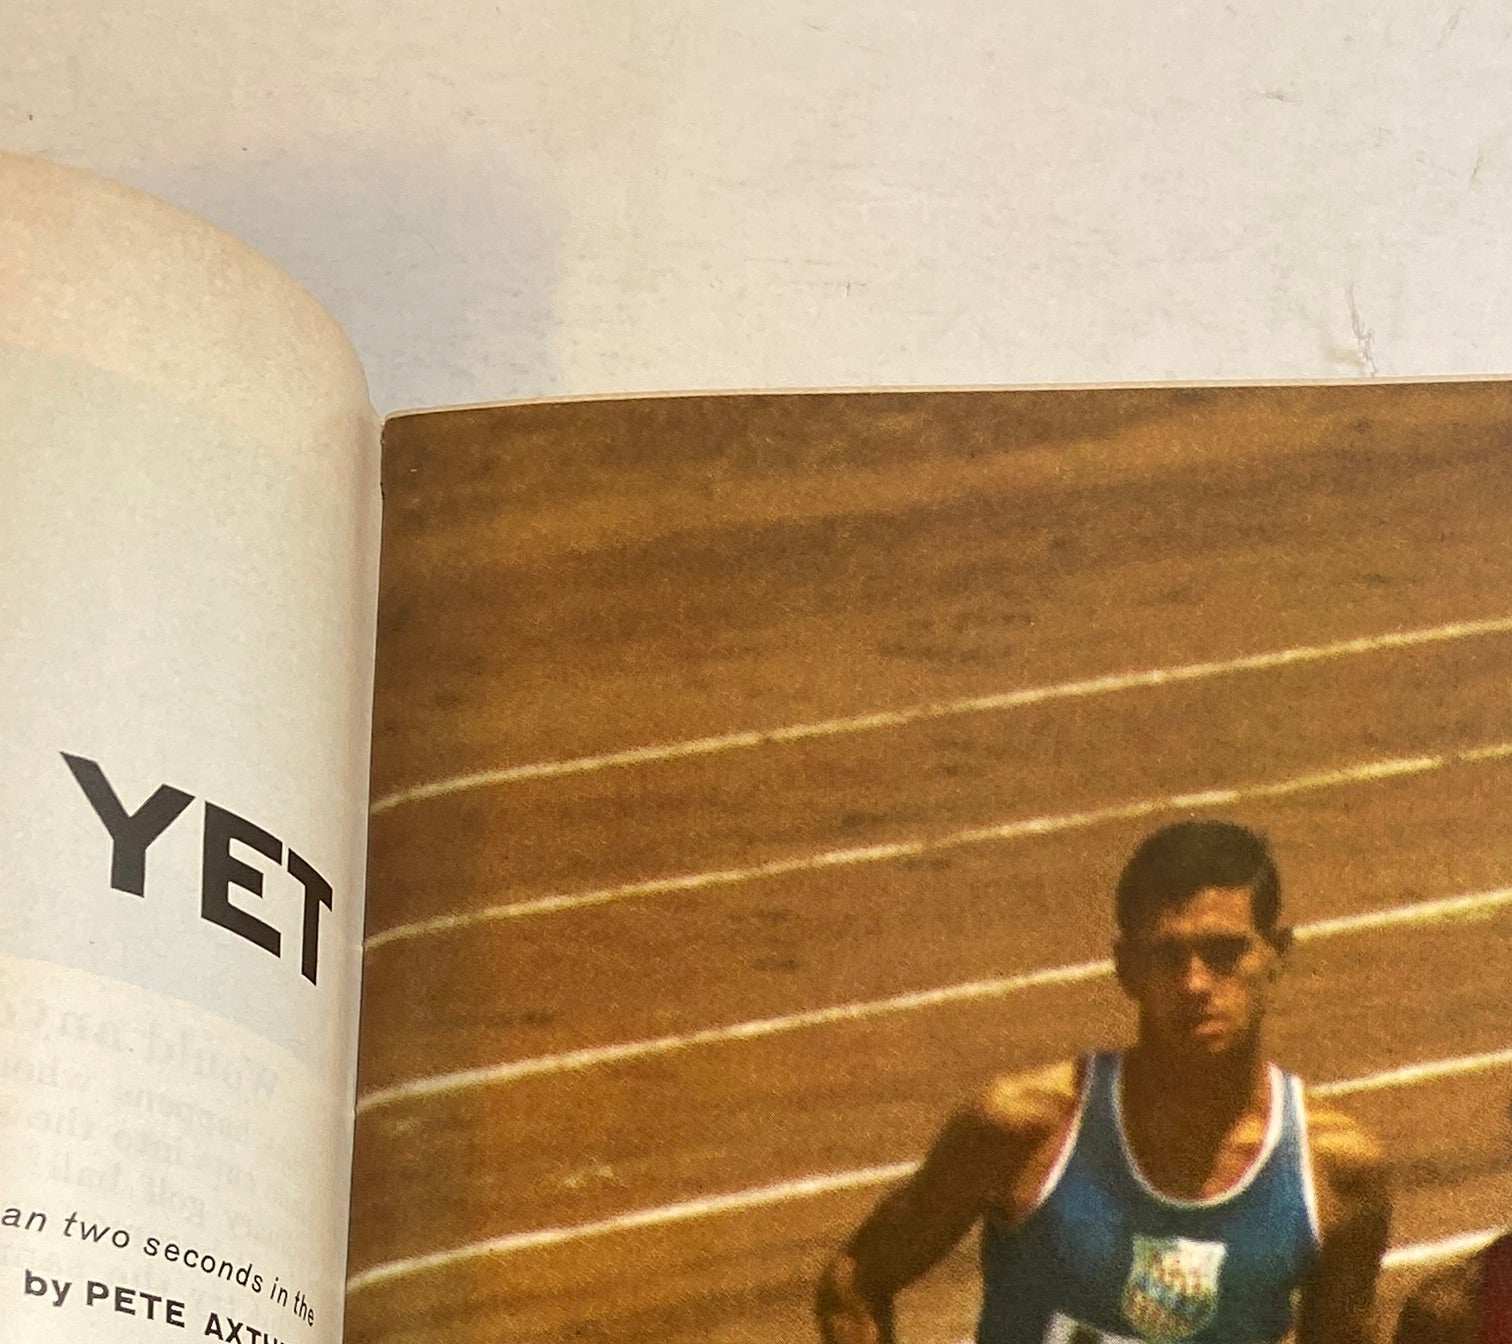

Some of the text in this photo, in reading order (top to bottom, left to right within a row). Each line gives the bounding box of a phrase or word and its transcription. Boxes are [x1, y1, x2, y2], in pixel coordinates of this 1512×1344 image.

[59, 751, 333, 986] YET
[2, 1207, 315, 1328] an two seconds in the
[24, 1269, 72, 1308] by
[86, 1280, 186, 1329] PETE
